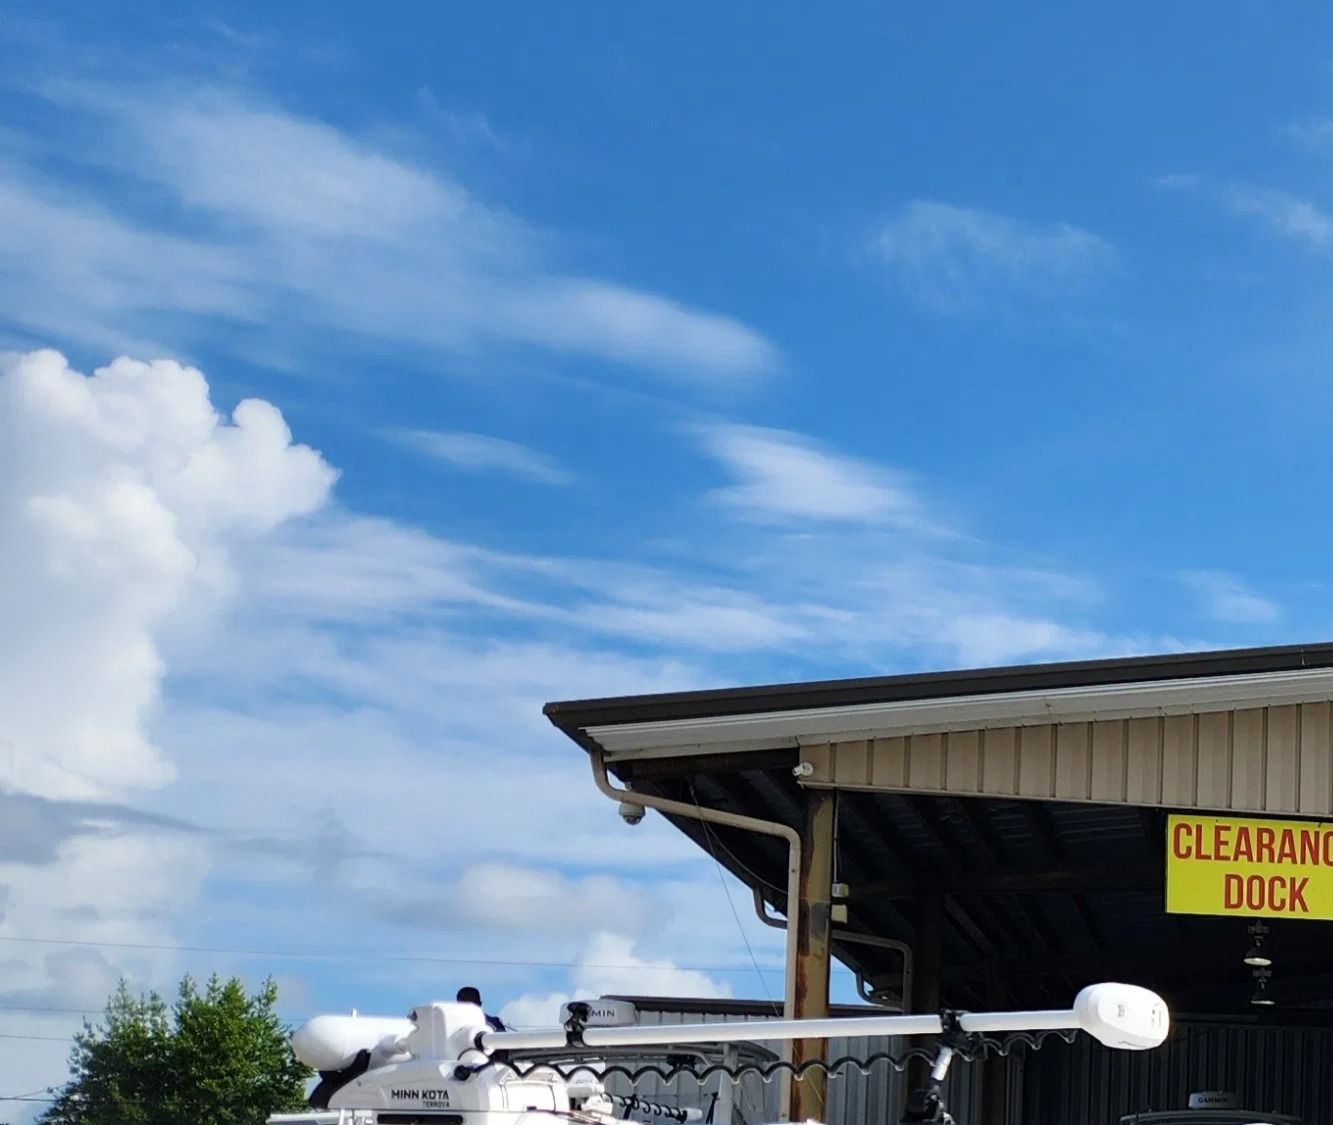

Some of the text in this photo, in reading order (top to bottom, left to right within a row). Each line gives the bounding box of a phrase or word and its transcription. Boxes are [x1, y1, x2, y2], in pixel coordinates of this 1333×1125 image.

[1224, 873, 1310, 913] DOCK
[391, 1089, 449, 1100] MINN KOTA
